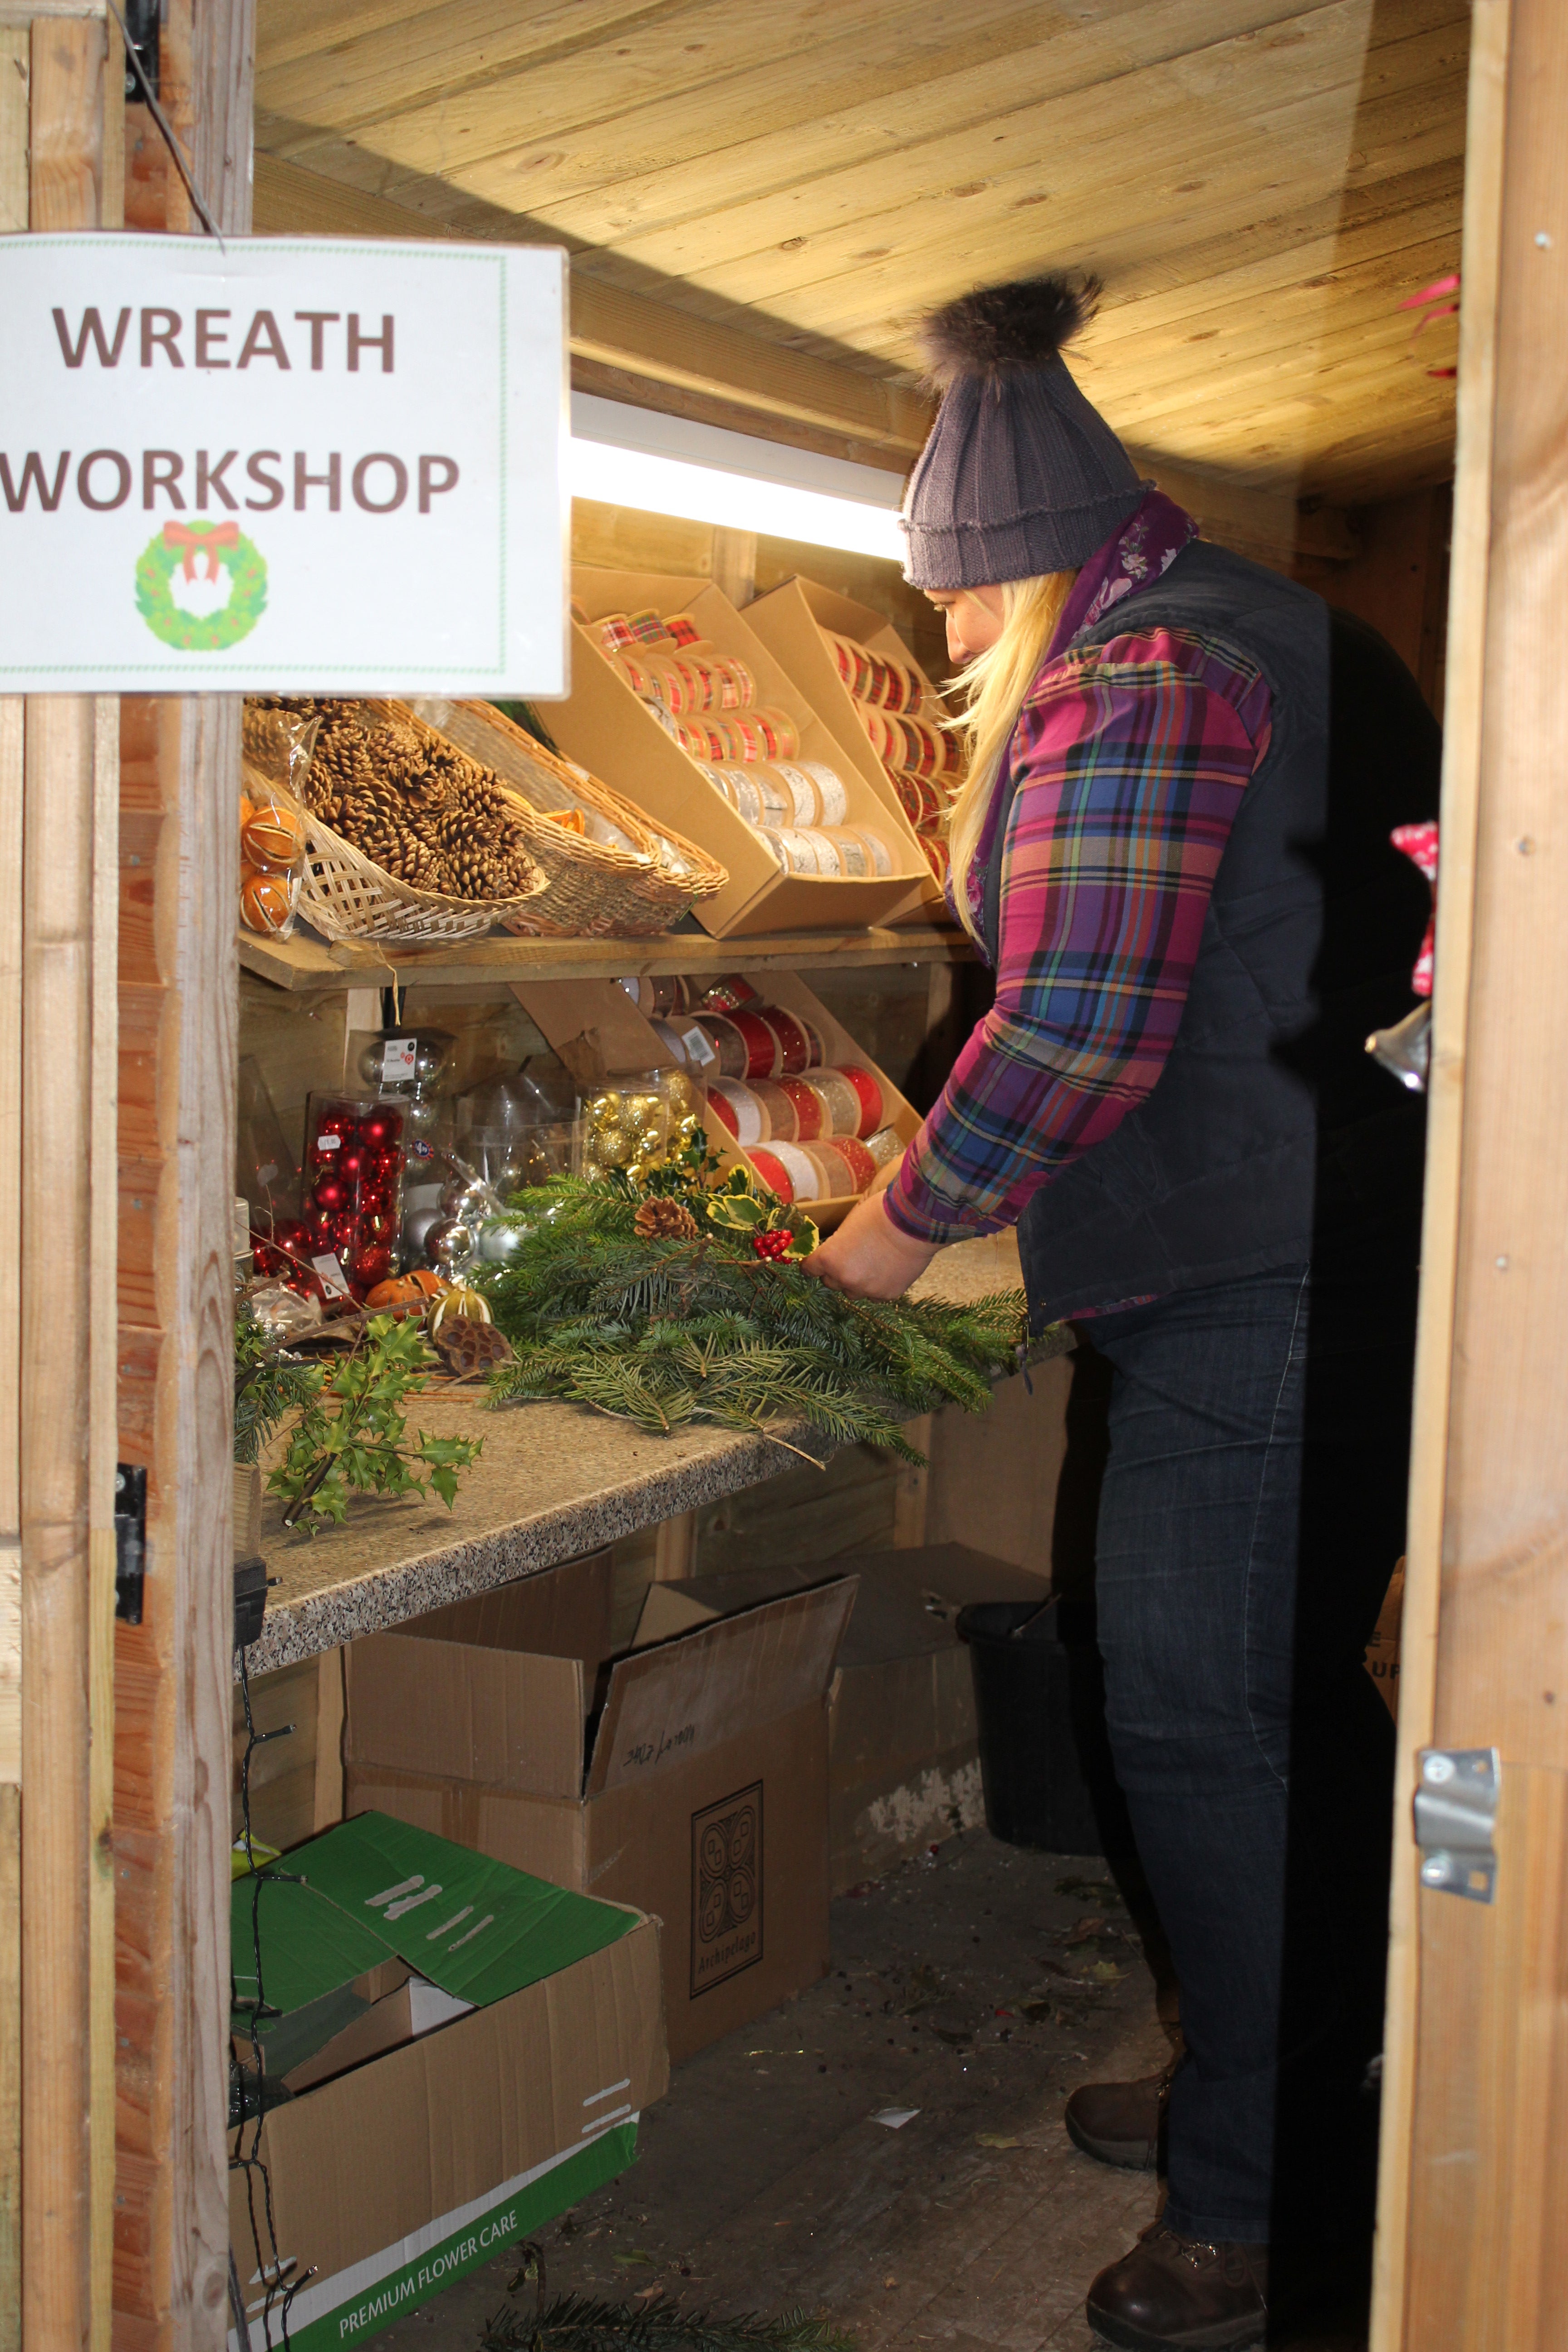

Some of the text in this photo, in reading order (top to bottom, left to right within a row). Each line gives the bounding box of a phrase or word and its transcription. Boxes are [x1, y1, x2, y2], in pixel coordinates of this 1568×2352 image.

[52, 307, 395, 373] WREATH
[0, 449, 461, 514] WORKSHOP
[698, 1931, 756, 1974] Archipelago
[339, 2210, 518, 2339] PREMIUM FLOWER CARE
